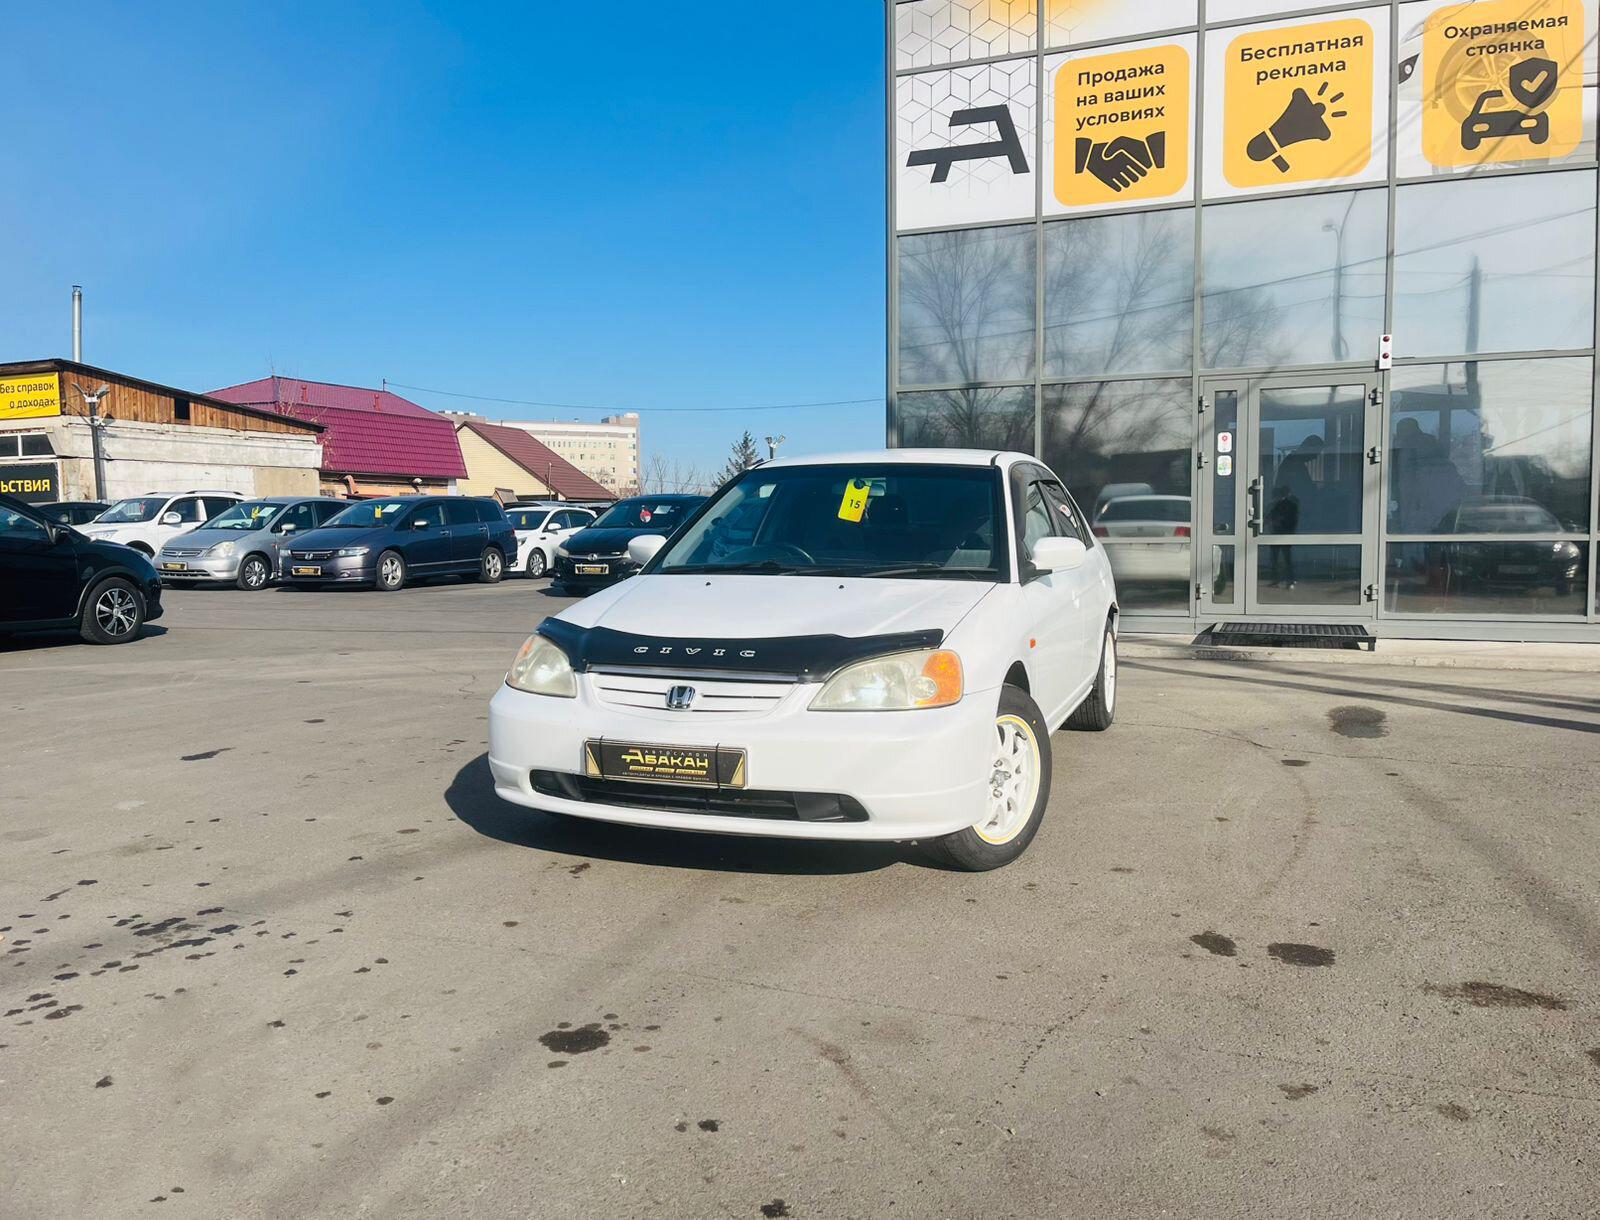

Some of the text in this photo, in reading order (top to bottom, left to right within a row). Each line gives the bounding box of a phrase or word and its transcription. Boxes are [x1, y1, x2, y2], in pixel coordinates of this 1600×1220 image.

[1444, 15, 1568, 39] Охраняемая
[1240, 35, 1364, 62] Бесплатная
[1466, 39, 1544, 57] стоянка
[1078, 63, 1165, 87] Продажа
[1256, 60, 1346, 85] реклама
[1076, 84, 1165, 107] на ваших
[1075, 106, 1165, 131] условиях
[17, 382, 54, 394] справок
[10, 398, 56, 409] о доходах
[0, 479, 51, 493] ЬСТВИЯ
[849, 499, 861, 509] 15
[633, 646, 756, 658] CIVIC
[621, 749, 709, 768] АБАКАН
